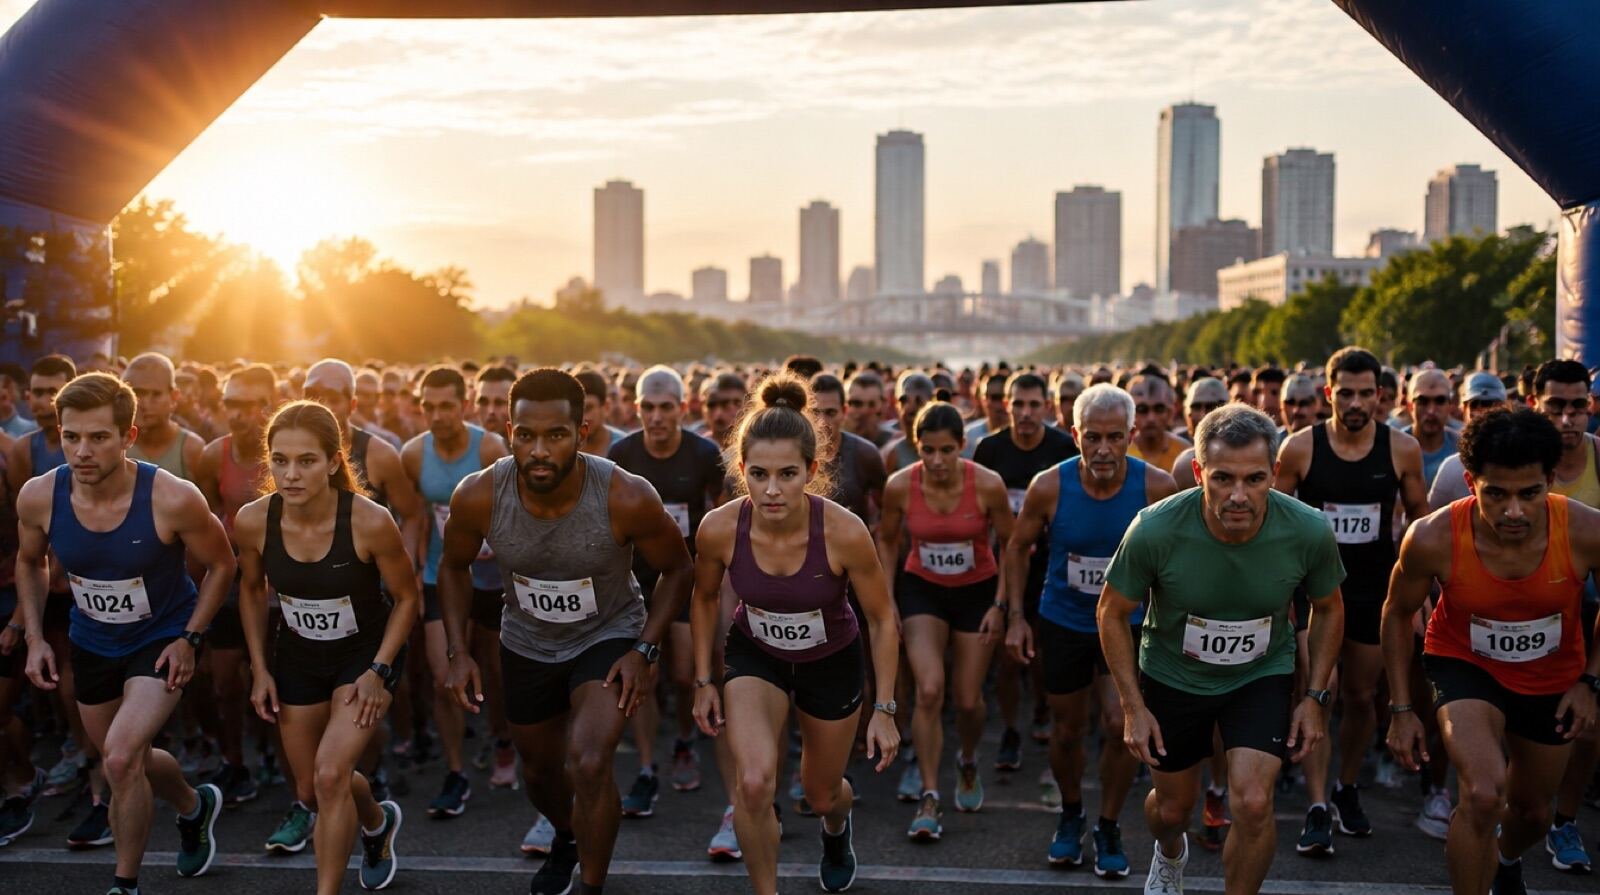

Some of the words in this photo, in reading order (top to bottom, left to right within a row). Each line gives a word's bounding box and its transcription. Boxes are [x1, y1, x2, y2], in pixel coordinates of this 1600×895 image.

[1333, 517, 1371, 534] 1178
[929, 552, 965, 567] 1146
[1079, 569, 1104, 586] 112
[82, 593, 135, 613] 1024
[528, 593, 581, 612] 1048
[292, 611, 340, 630] 1037
[759, 622, 812, 640] 1062
[1200, 633, 1256, 654] 1075
[1486, 632, 1546, 652] 1089
